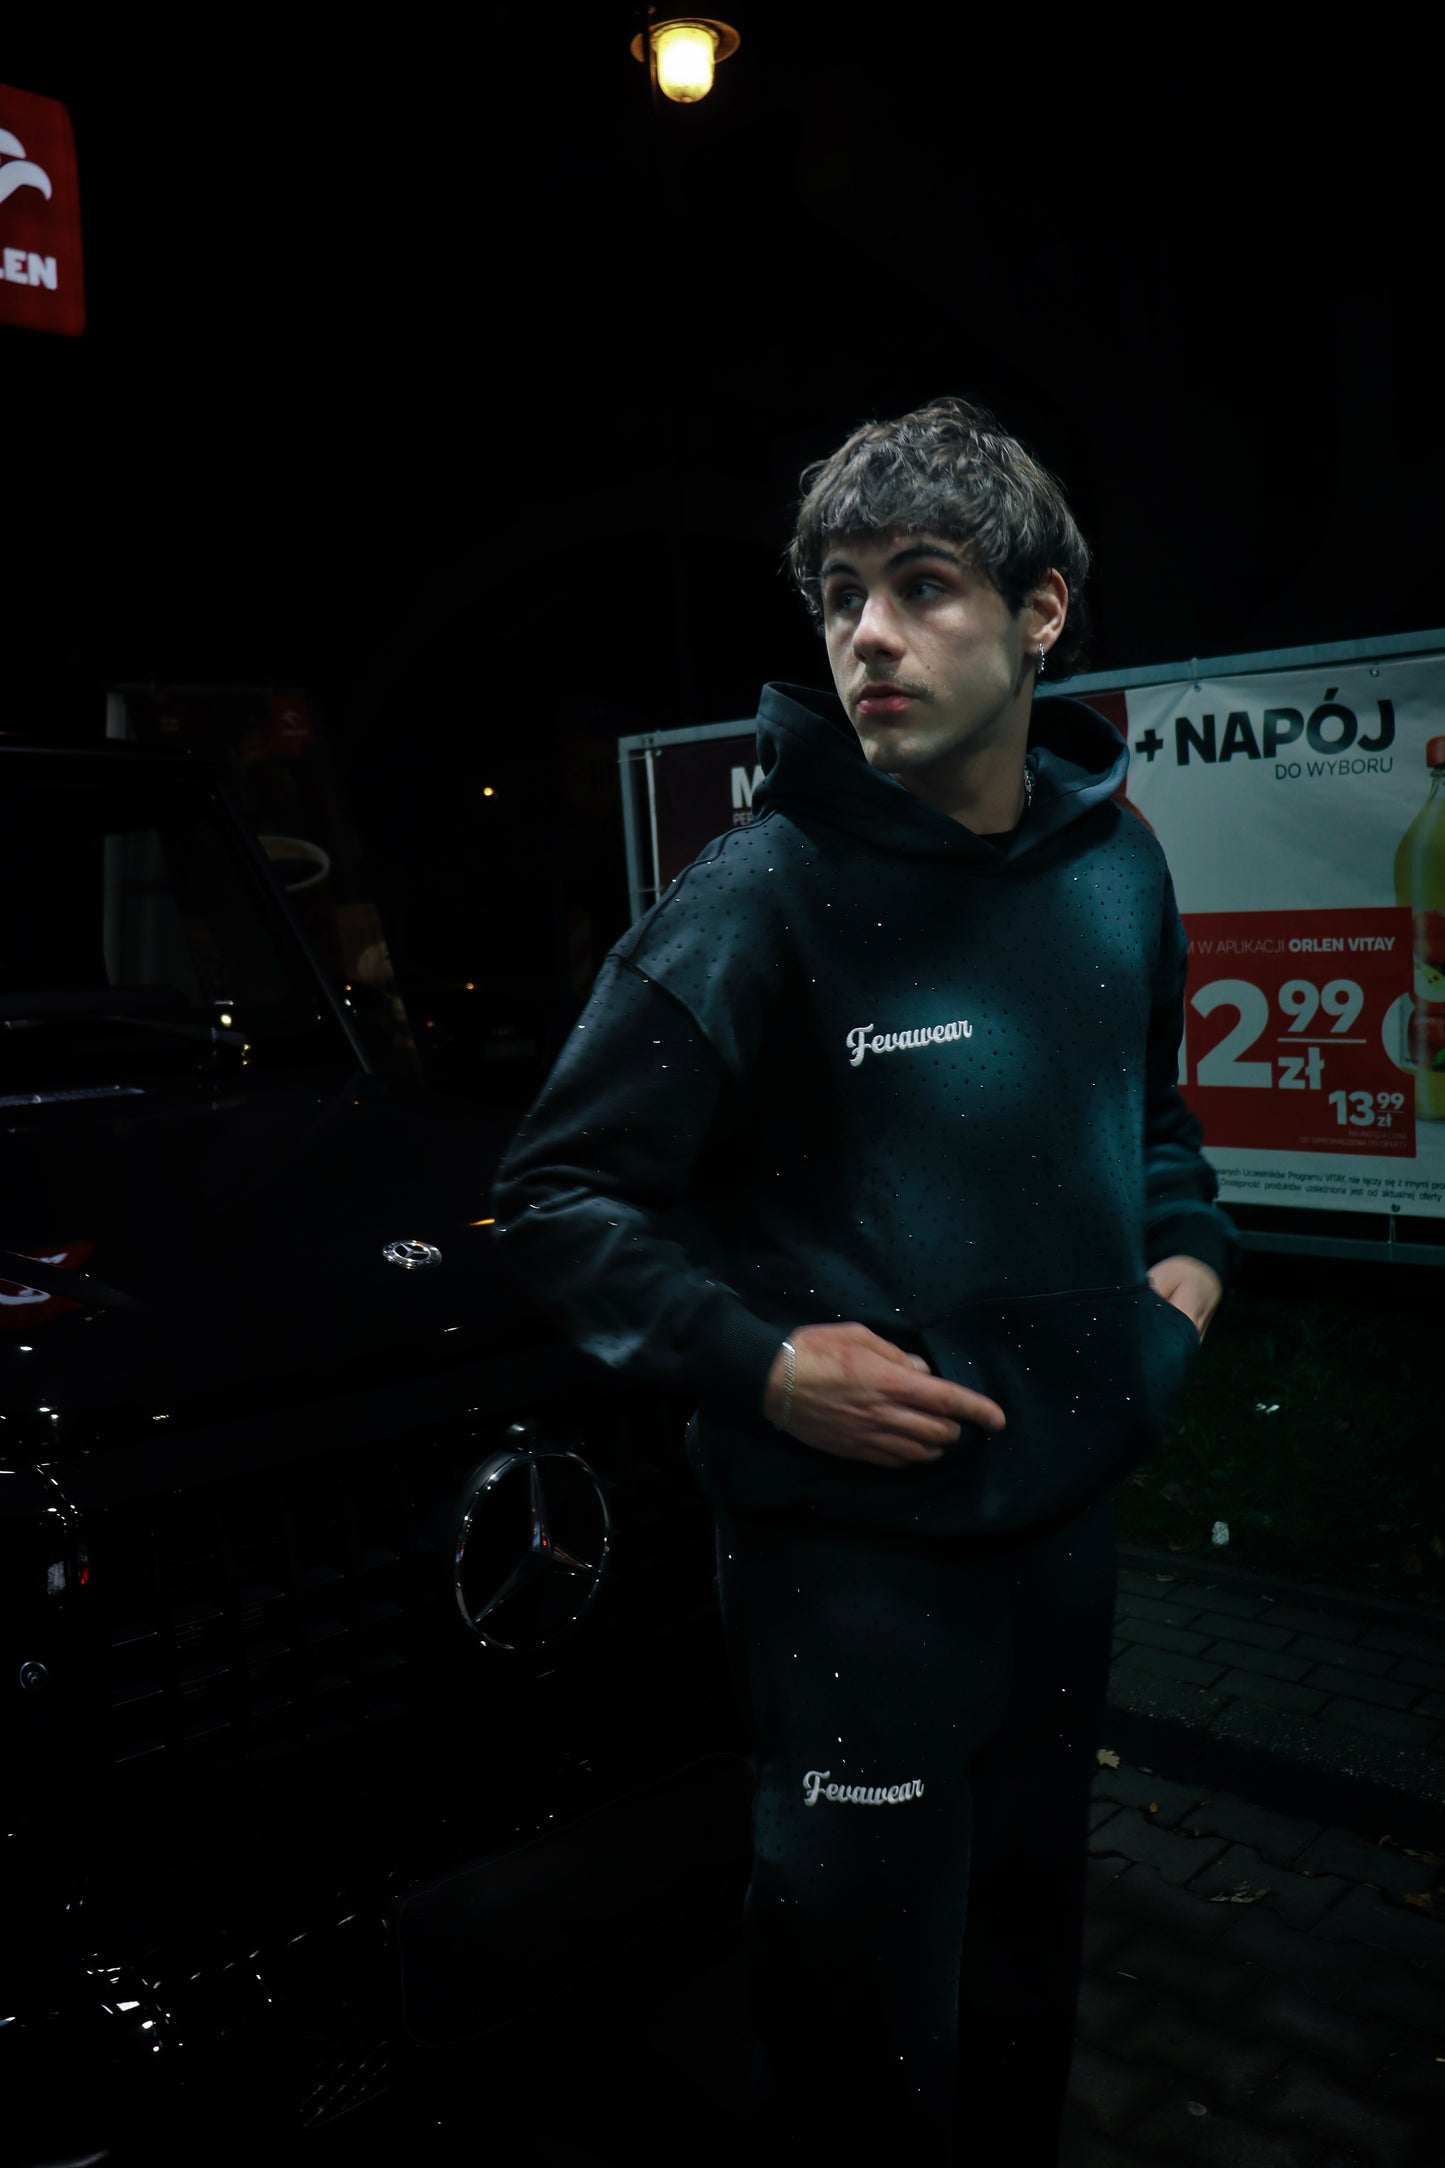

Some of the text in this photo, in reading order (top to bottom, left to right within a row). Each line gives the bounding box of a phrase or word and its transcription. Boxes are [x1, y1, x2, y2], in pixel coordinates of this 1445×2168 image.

[0, 246, 59, 291] EN
[1175, 688, 1396, 766] NAPÓJ
[1275, 757, 1394, 780] DO WYBORU
[1197, 940, 1213, 954] W
[1216, 938, 1286, 954] APLIKACJI
[1288, 937, 1345, 953] ORLEN
[1347, 936, 1396, 952] VITAY
[846, 1020, 973, 1067] Fevawear
[1177, 978, 1364, 1089] 2 99
[1277, 1046, 1326, 1090] zł
[1328, 1090, 1405, 1127] 13 99
[1377, 1113, 1392, 1128] zł
[803, 1770, 925, 1807] Fevawear
